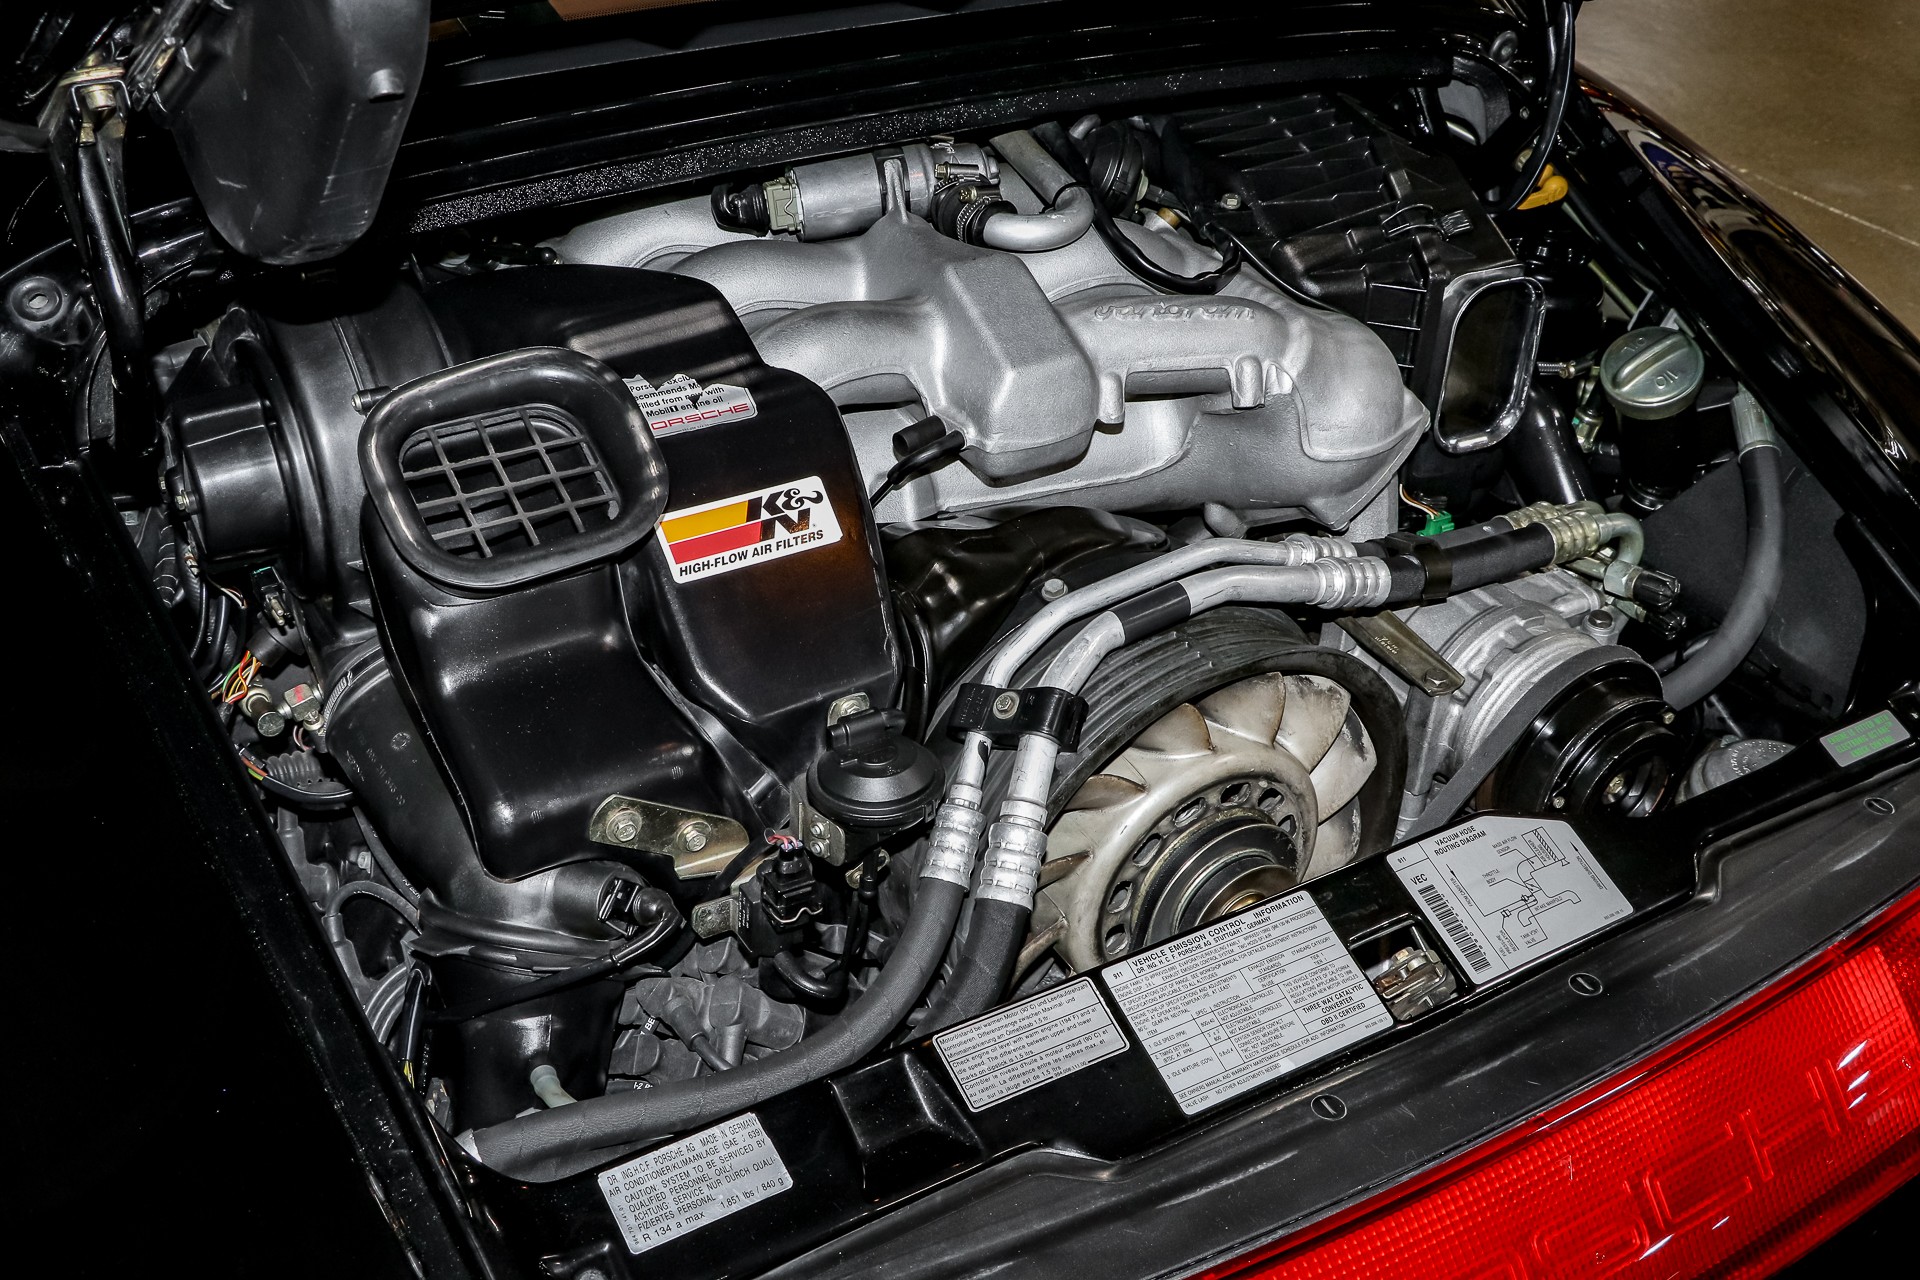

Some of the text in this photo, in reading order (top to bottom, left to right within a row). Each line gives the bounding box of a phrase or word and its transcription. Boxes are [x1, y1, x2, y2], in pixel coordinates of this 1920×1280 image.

[633, 384, 687, 401] ecommends
[662, 397, 683, 405] from
[705, 387, 724, 395] with
[651, 403, 749, 430] ORSCHE
[679, 530, 824, 576] HIGH-FLOW AIR FILTERS
[1434, 830, 1486, 856] ROUTING DIAGRAM
[1435, 826, 1476, 846] VACUUM HOSE
[1410, 874, 1427, 885] VEC
[1132, 949, 1167, 966] VEHICLE
[1168, 934, 1206, 953] EMISSION
[1208, 919, 1246, 937] CONTROL
[1253, 895, 1304, 919] INFORMATION
[1178, 944, 1203, 957] PORSCHE
[1213, 927, 1243, 943] STUTTGART
[1247, 917, 1271, 929] GERMANY
[1302, 984, 1363, 1013] THREE WAY CATALYTIC
[1321, 1017, 1333, 1025] OBD
[1338, 1003, 1365, 1017] CERTIFIED
[1322, 996, 1354, 1013] CONVERTER
[952, 1058, 969, 1068] Check
[971, 1051, 989, 1060] engine
[998, 1041, 1011, 1049] level
[1025, 1031, 1039, 1039] warm
[1041, 1023, 1058, 1033] engine
[1026, 1035, 1049, 1047] between
[1050, 1029, 1065, 1037] upper
[1067, 1023, 1077, 1031] and
[1077, 1018, 1091, 1026] lower
[1000, 1066, 1018, 1076] niveau
[1045, 1048, 1063, 1058] moteur
[1065, 1039, 1082, 1050] chaud
[960, 1073, 977, 1082] marks
[653, 1147, 684, 1166] PORSCHE
[699, 1133, 718, 1147] MADE
[729, 1117, 757, 1135] GERMANY
[609, 1186, 621, 1197] AIR
[624, 1145, 720, 1191] CONDITIONER/KLIMAANLAGE
[722, 1138, 739, 1150] (SAE
[748, 1128, 762, 1139] 639)
[625, 1184, 659, 1203] CAUTION:
[661, 1170, 690, 1188] SYSTEM
[719, 1144, 754, 1164] SERVICED
[629, 1163, 733, 1213] QUALIFIED PERSONNEL ONLY
[634, 1157, 775, 1222] ACHTUNG: SERVICE NUR DURCH QUALI-
[638, 1194, 716, 1231] FIZIERTES PERSONAL
[655, 1224, 671, 1236] 134
[685, 1212, 705, 1224] max
[742, 1190, 754, 1199] lbs
[761, 1180, 775, 1191] 840
